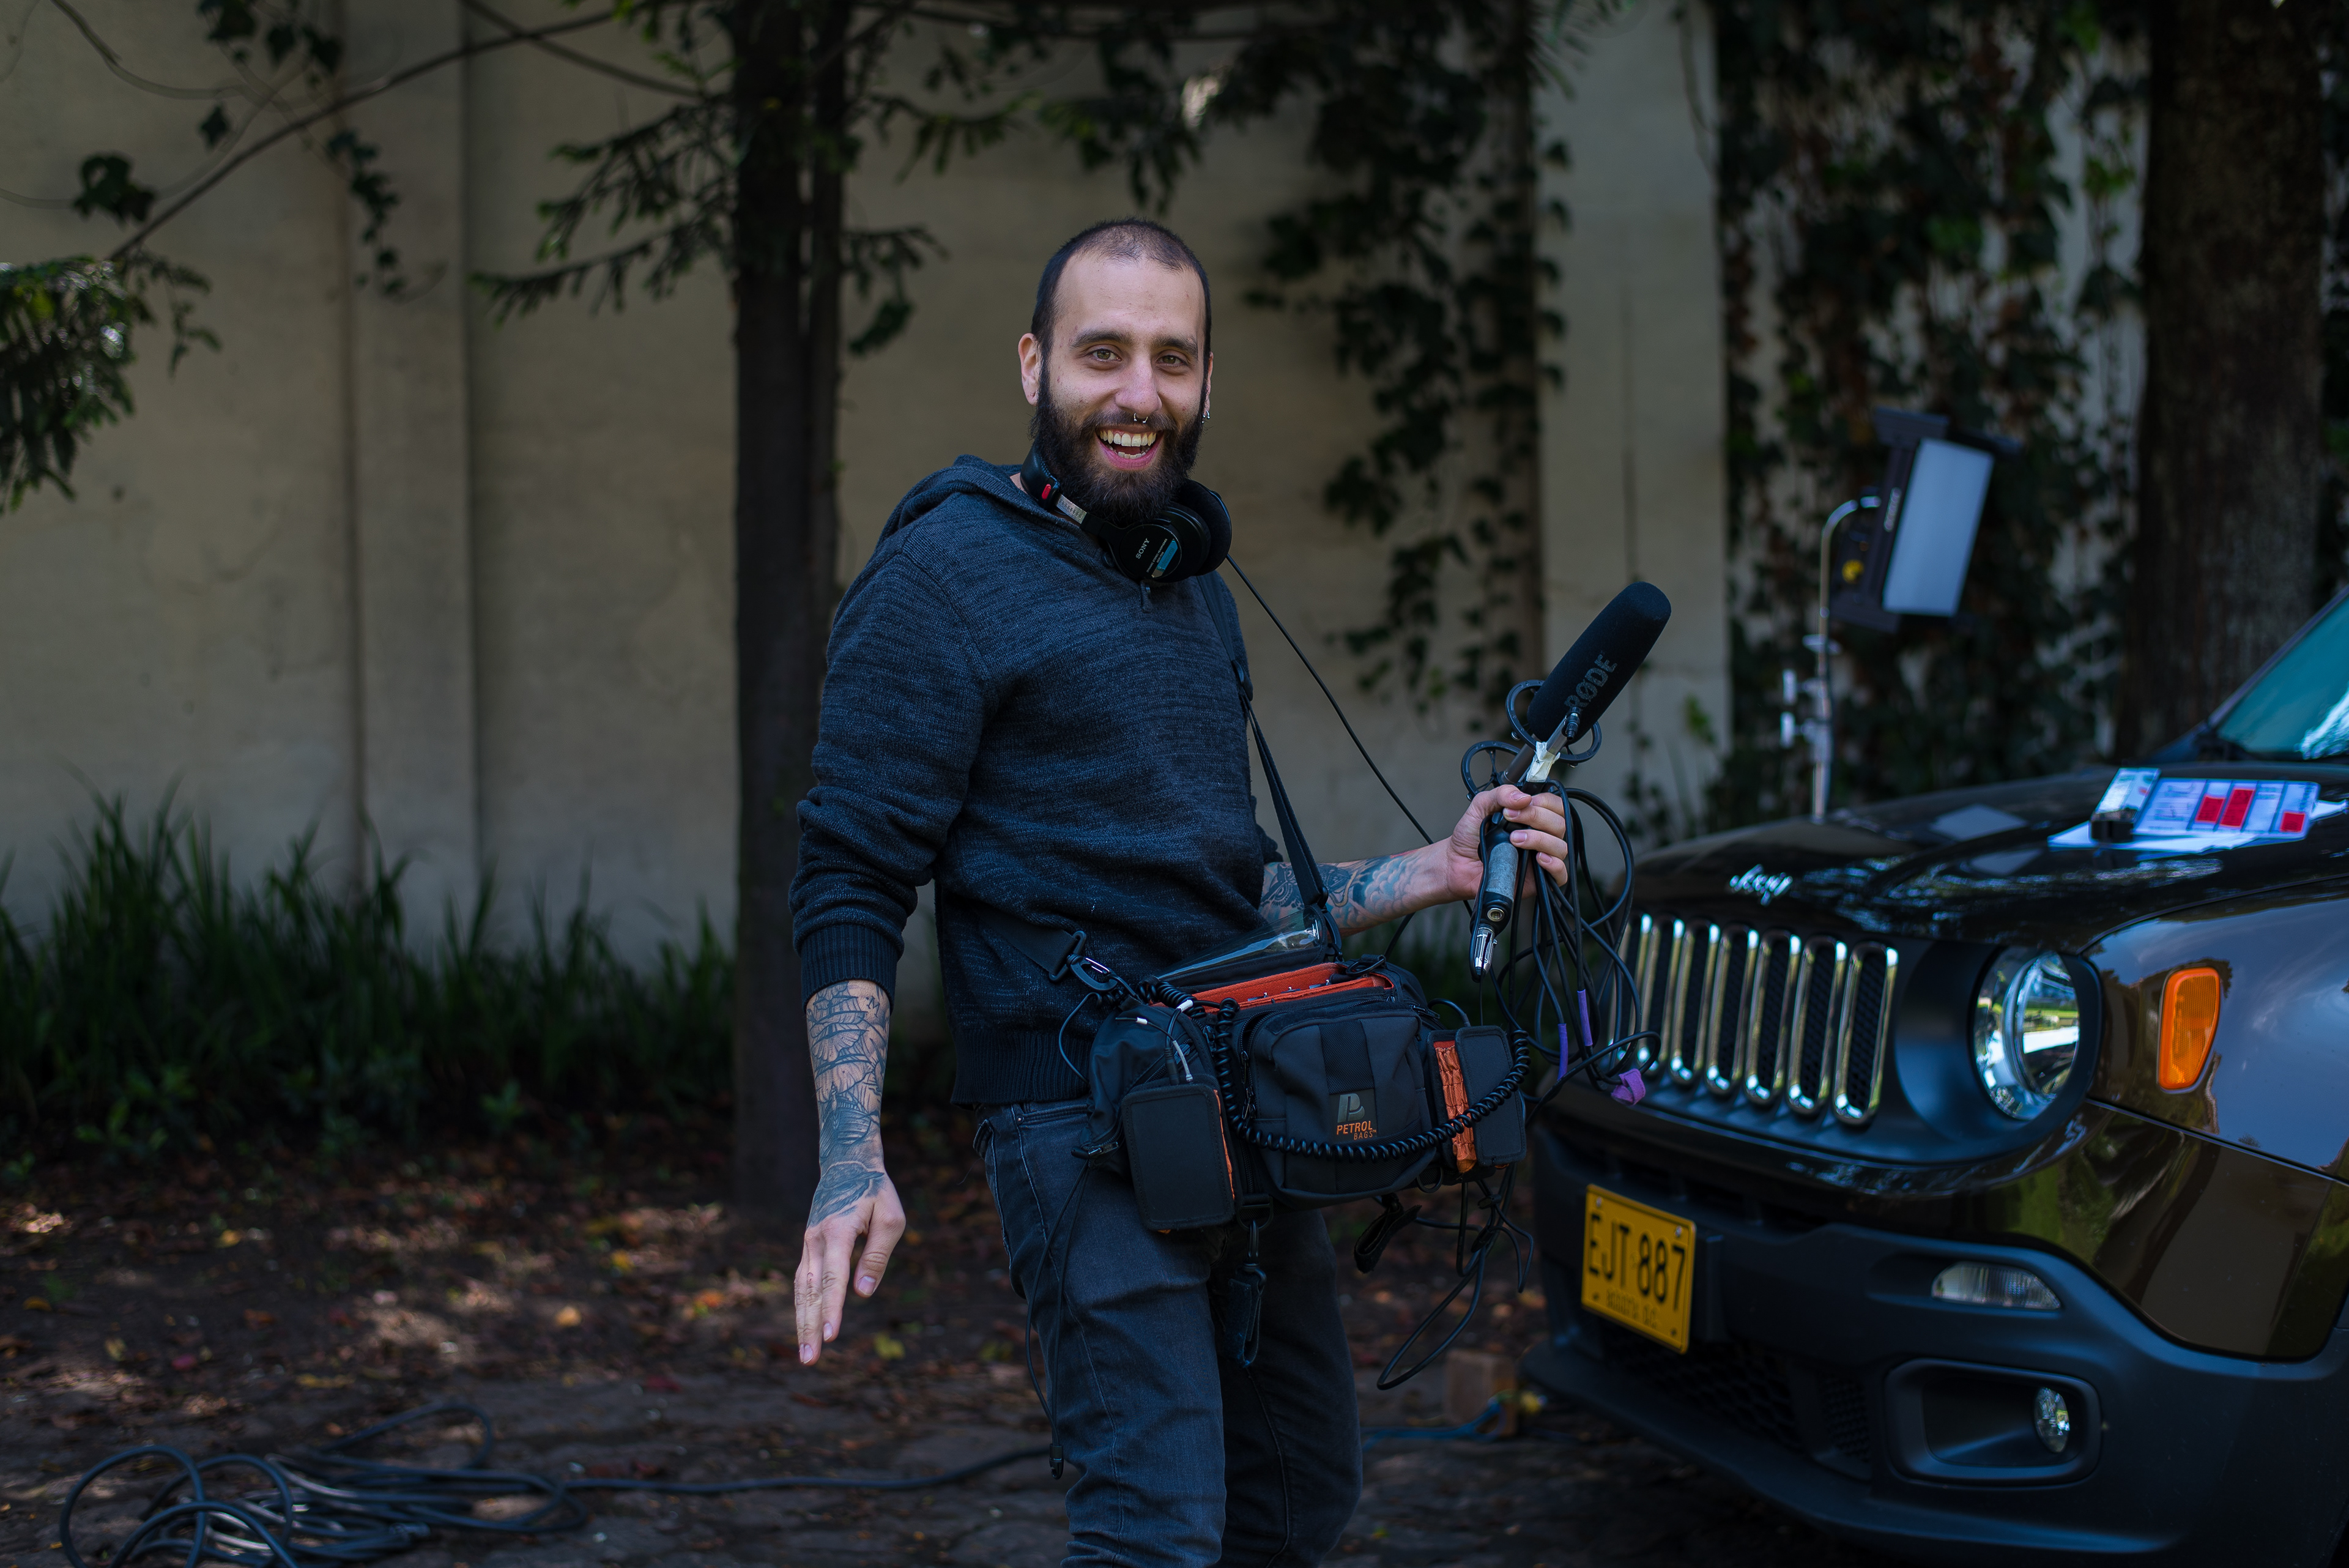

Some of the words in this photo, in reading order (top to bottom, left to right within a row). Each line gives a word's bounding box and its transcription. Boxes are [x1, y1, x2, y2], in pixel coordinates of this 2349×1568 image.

[1135, 538, 1150, 559] SONY
[1336, 1120, 1373, 1135] PETROL
[1588, 1212, 1629, 1288] EJT
[1637, 1233, 1685, 1312] 887
